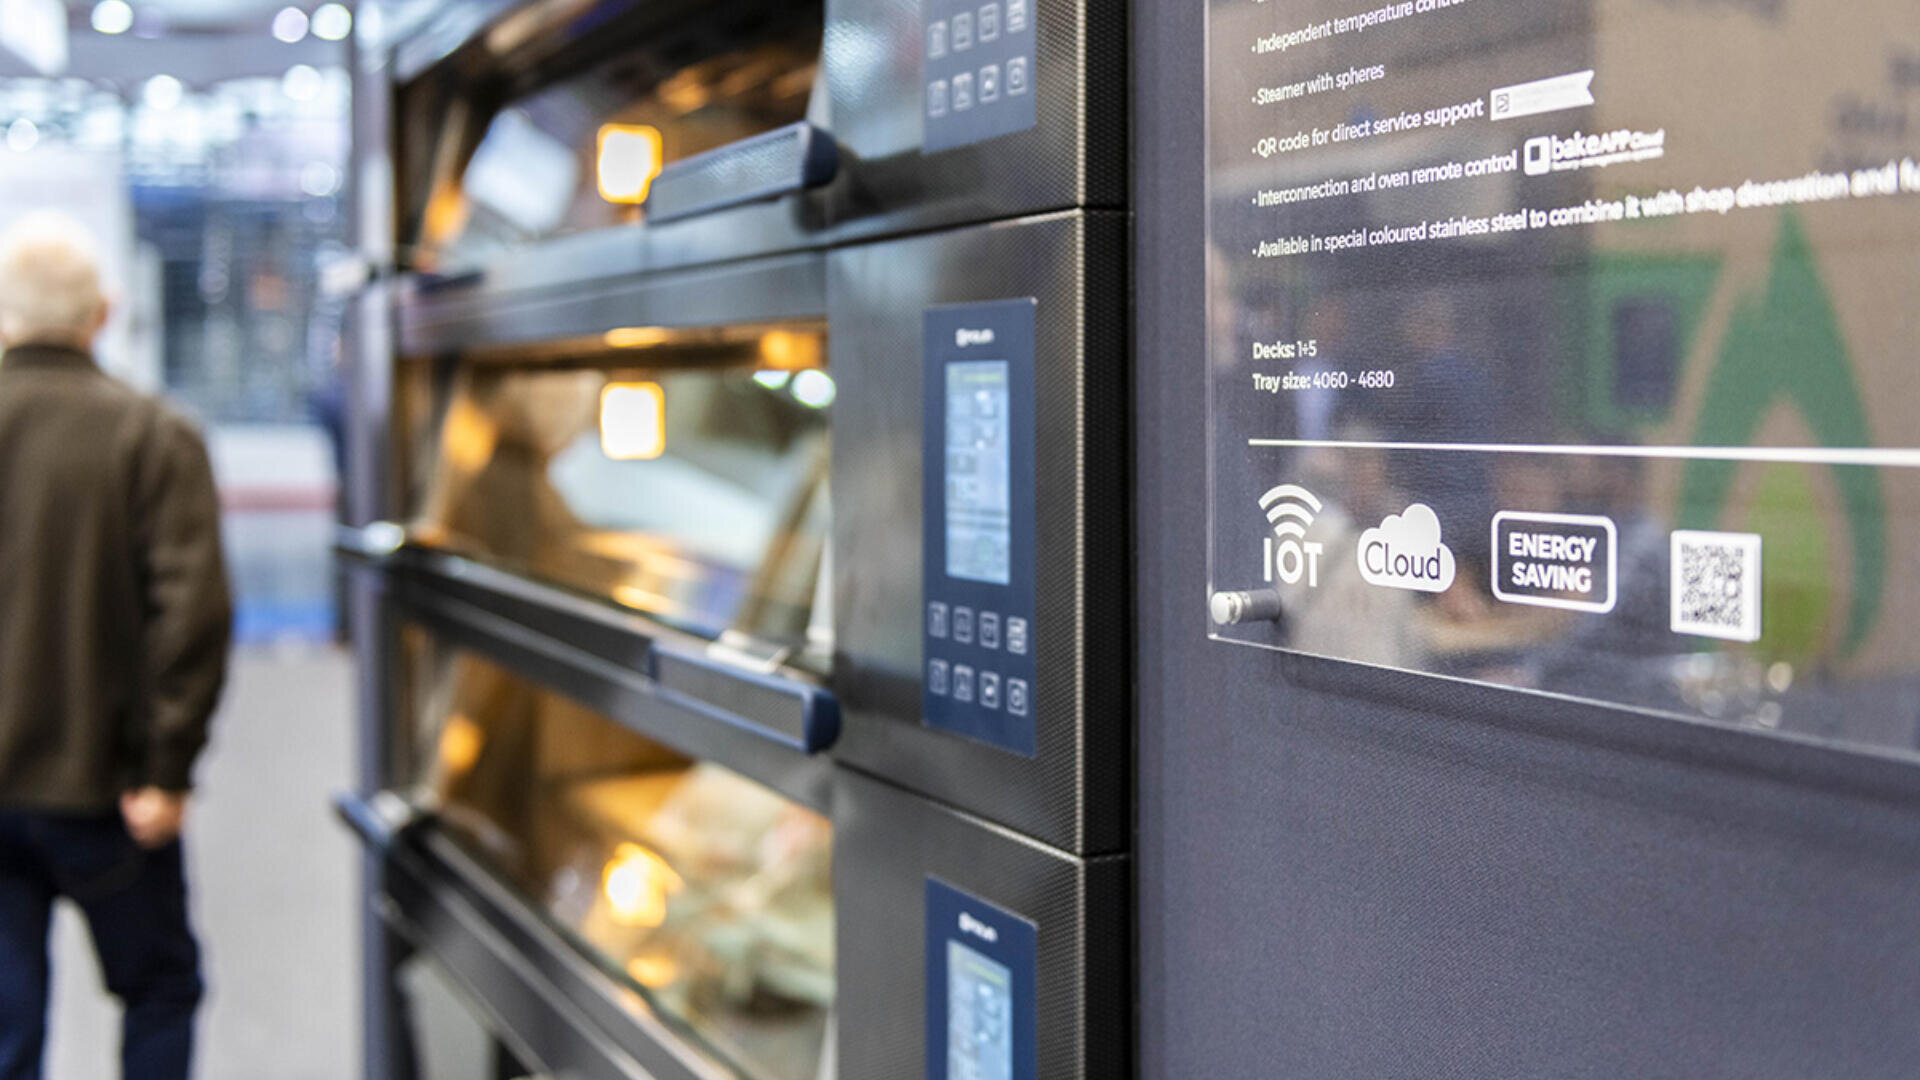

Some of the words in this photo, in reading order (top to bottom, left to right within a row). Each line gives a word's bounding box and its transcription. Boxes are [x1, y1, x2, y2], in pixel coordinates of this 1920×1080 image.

[1257, 20, 1332, 54] Independent
[1333, 2, 1413, 32] temperature
[1257, 81, 1305, 105] Steamer
[1306, 71, 1334, 94] with
[1335, 64, 1385, 90] spheres
[1257, 134, 1278, 158] QR
[1278, 131, 1310, 151] code
[1311, 127, 1330, 146] for
[1331, 120, 1371, 143] direct
[1373, 110, 1422, 135] service
[1423, 98, 1484, 127] support
[1257, 178, 1349, 207] Interconnection
[1351, 172, 1376, 193] and
[1378, 170, 1409, 189] oven
[1412, 160, 1462, 184] remote
[1465, 150, 1517, 177] control
[1257, 236, 1309, 258] Available
[1311, 235, 1322, 252] in
[1324, 229, 1367, 253] special
[1369, 221, 1427, 245] coloured
[1428, 215, 1489, 240] stainless
[1490, 208, 1527, 233] steel
[1529, 208, 1547, 228] to
[1549, 198, 1625, 227] combine
[1625, 194, 1640, 219] it
[1641, 189, 1684, 217] with
[1685, 185, 1735, 215] shop
[1735, 170, 1849, 208] decoration
[1850, 158, 1898, 197] and
[1252, 340, 1295, 359] Decks:
[1252, 372, 1280, 394] Tray
[1282, 371, 1311, 390] size:
[1313, 371, 1348, 389] 4060
[1358, 370, 1395, 389] 4680
[1263, 537, 1323, 587] IOT
[1364, 540, 1441, 580] Cloud
[1508, 532, 1597, 562] ENERGY
[1511, 562, 1592, 593] SAVING
